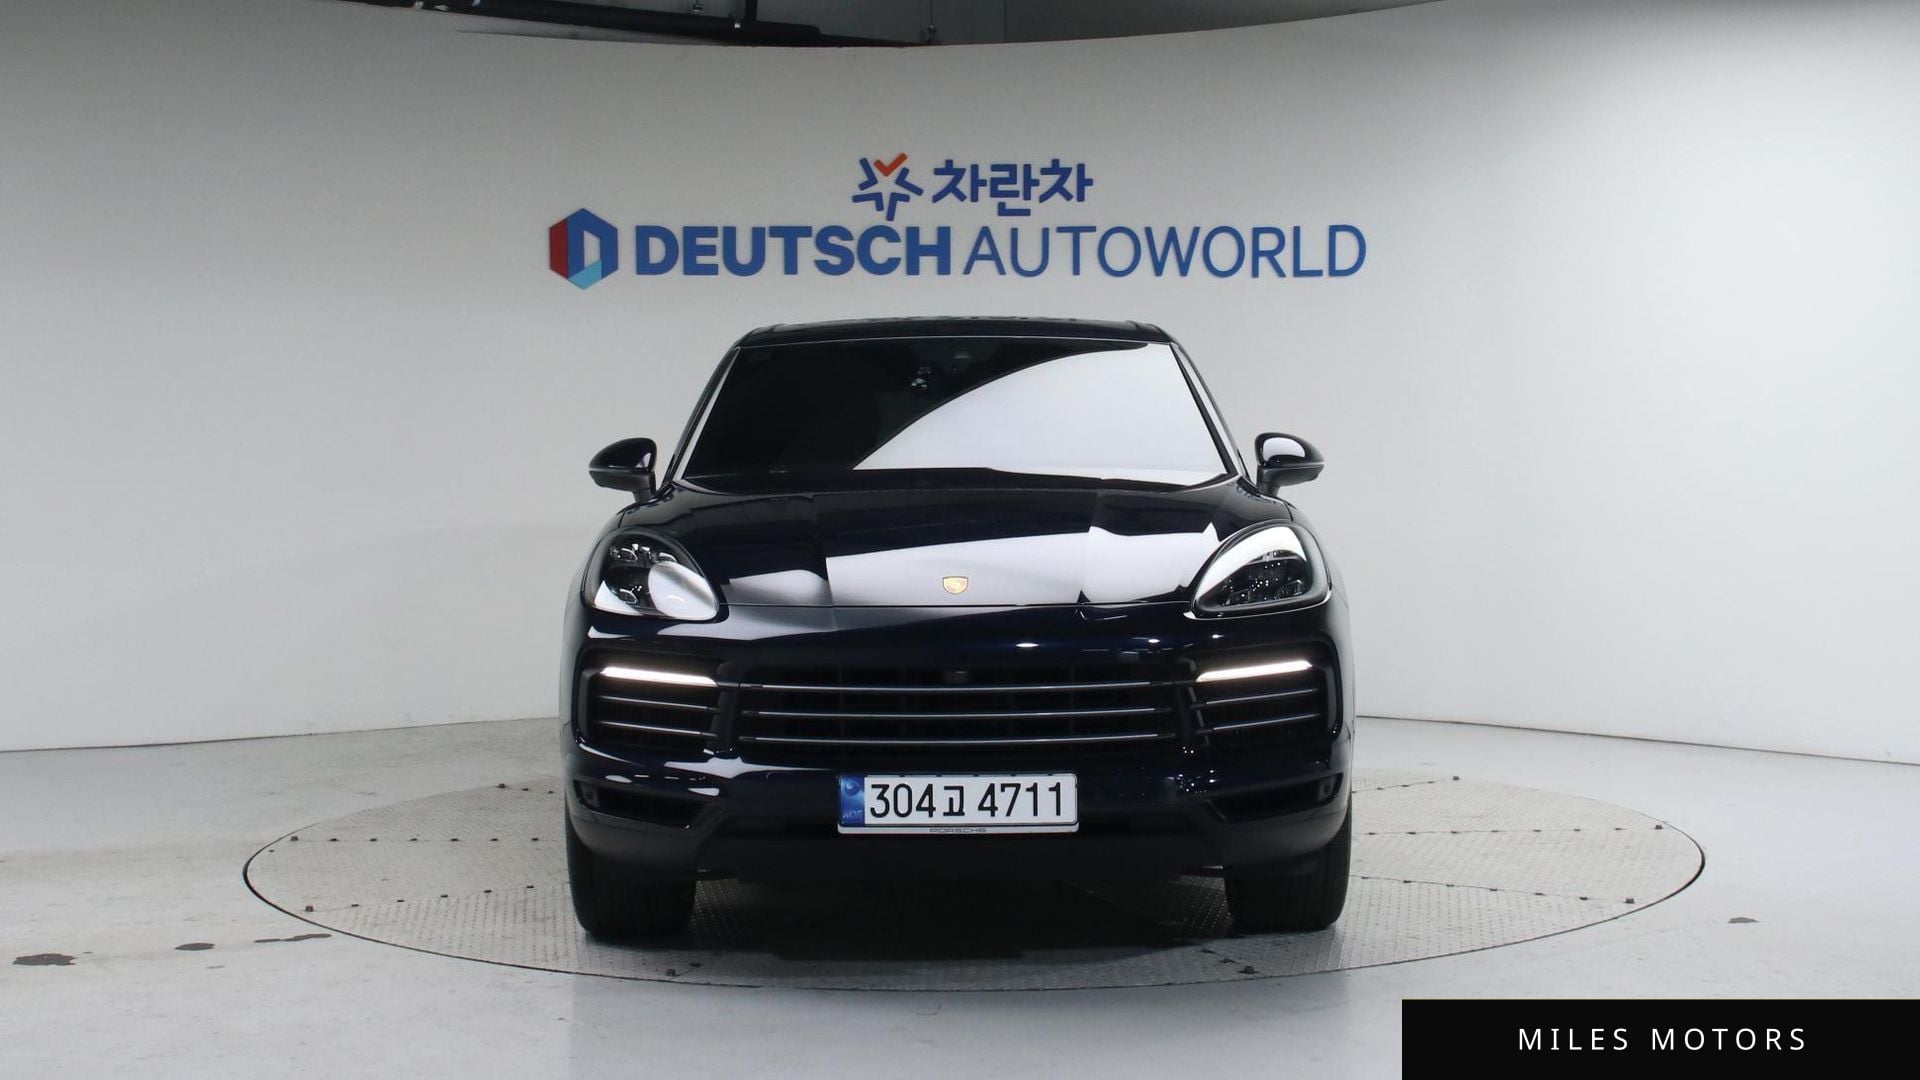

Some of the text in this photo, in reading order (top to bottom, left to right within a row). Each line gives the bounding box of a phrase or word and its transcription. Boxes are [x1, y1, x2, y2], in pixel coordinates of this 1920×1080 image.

[933, 159, 1094, 217] 차란차
[635, 224, 1368, 278] DEUTSCH AUTOWORLD
[977, 781, 1062, 818] 4711
